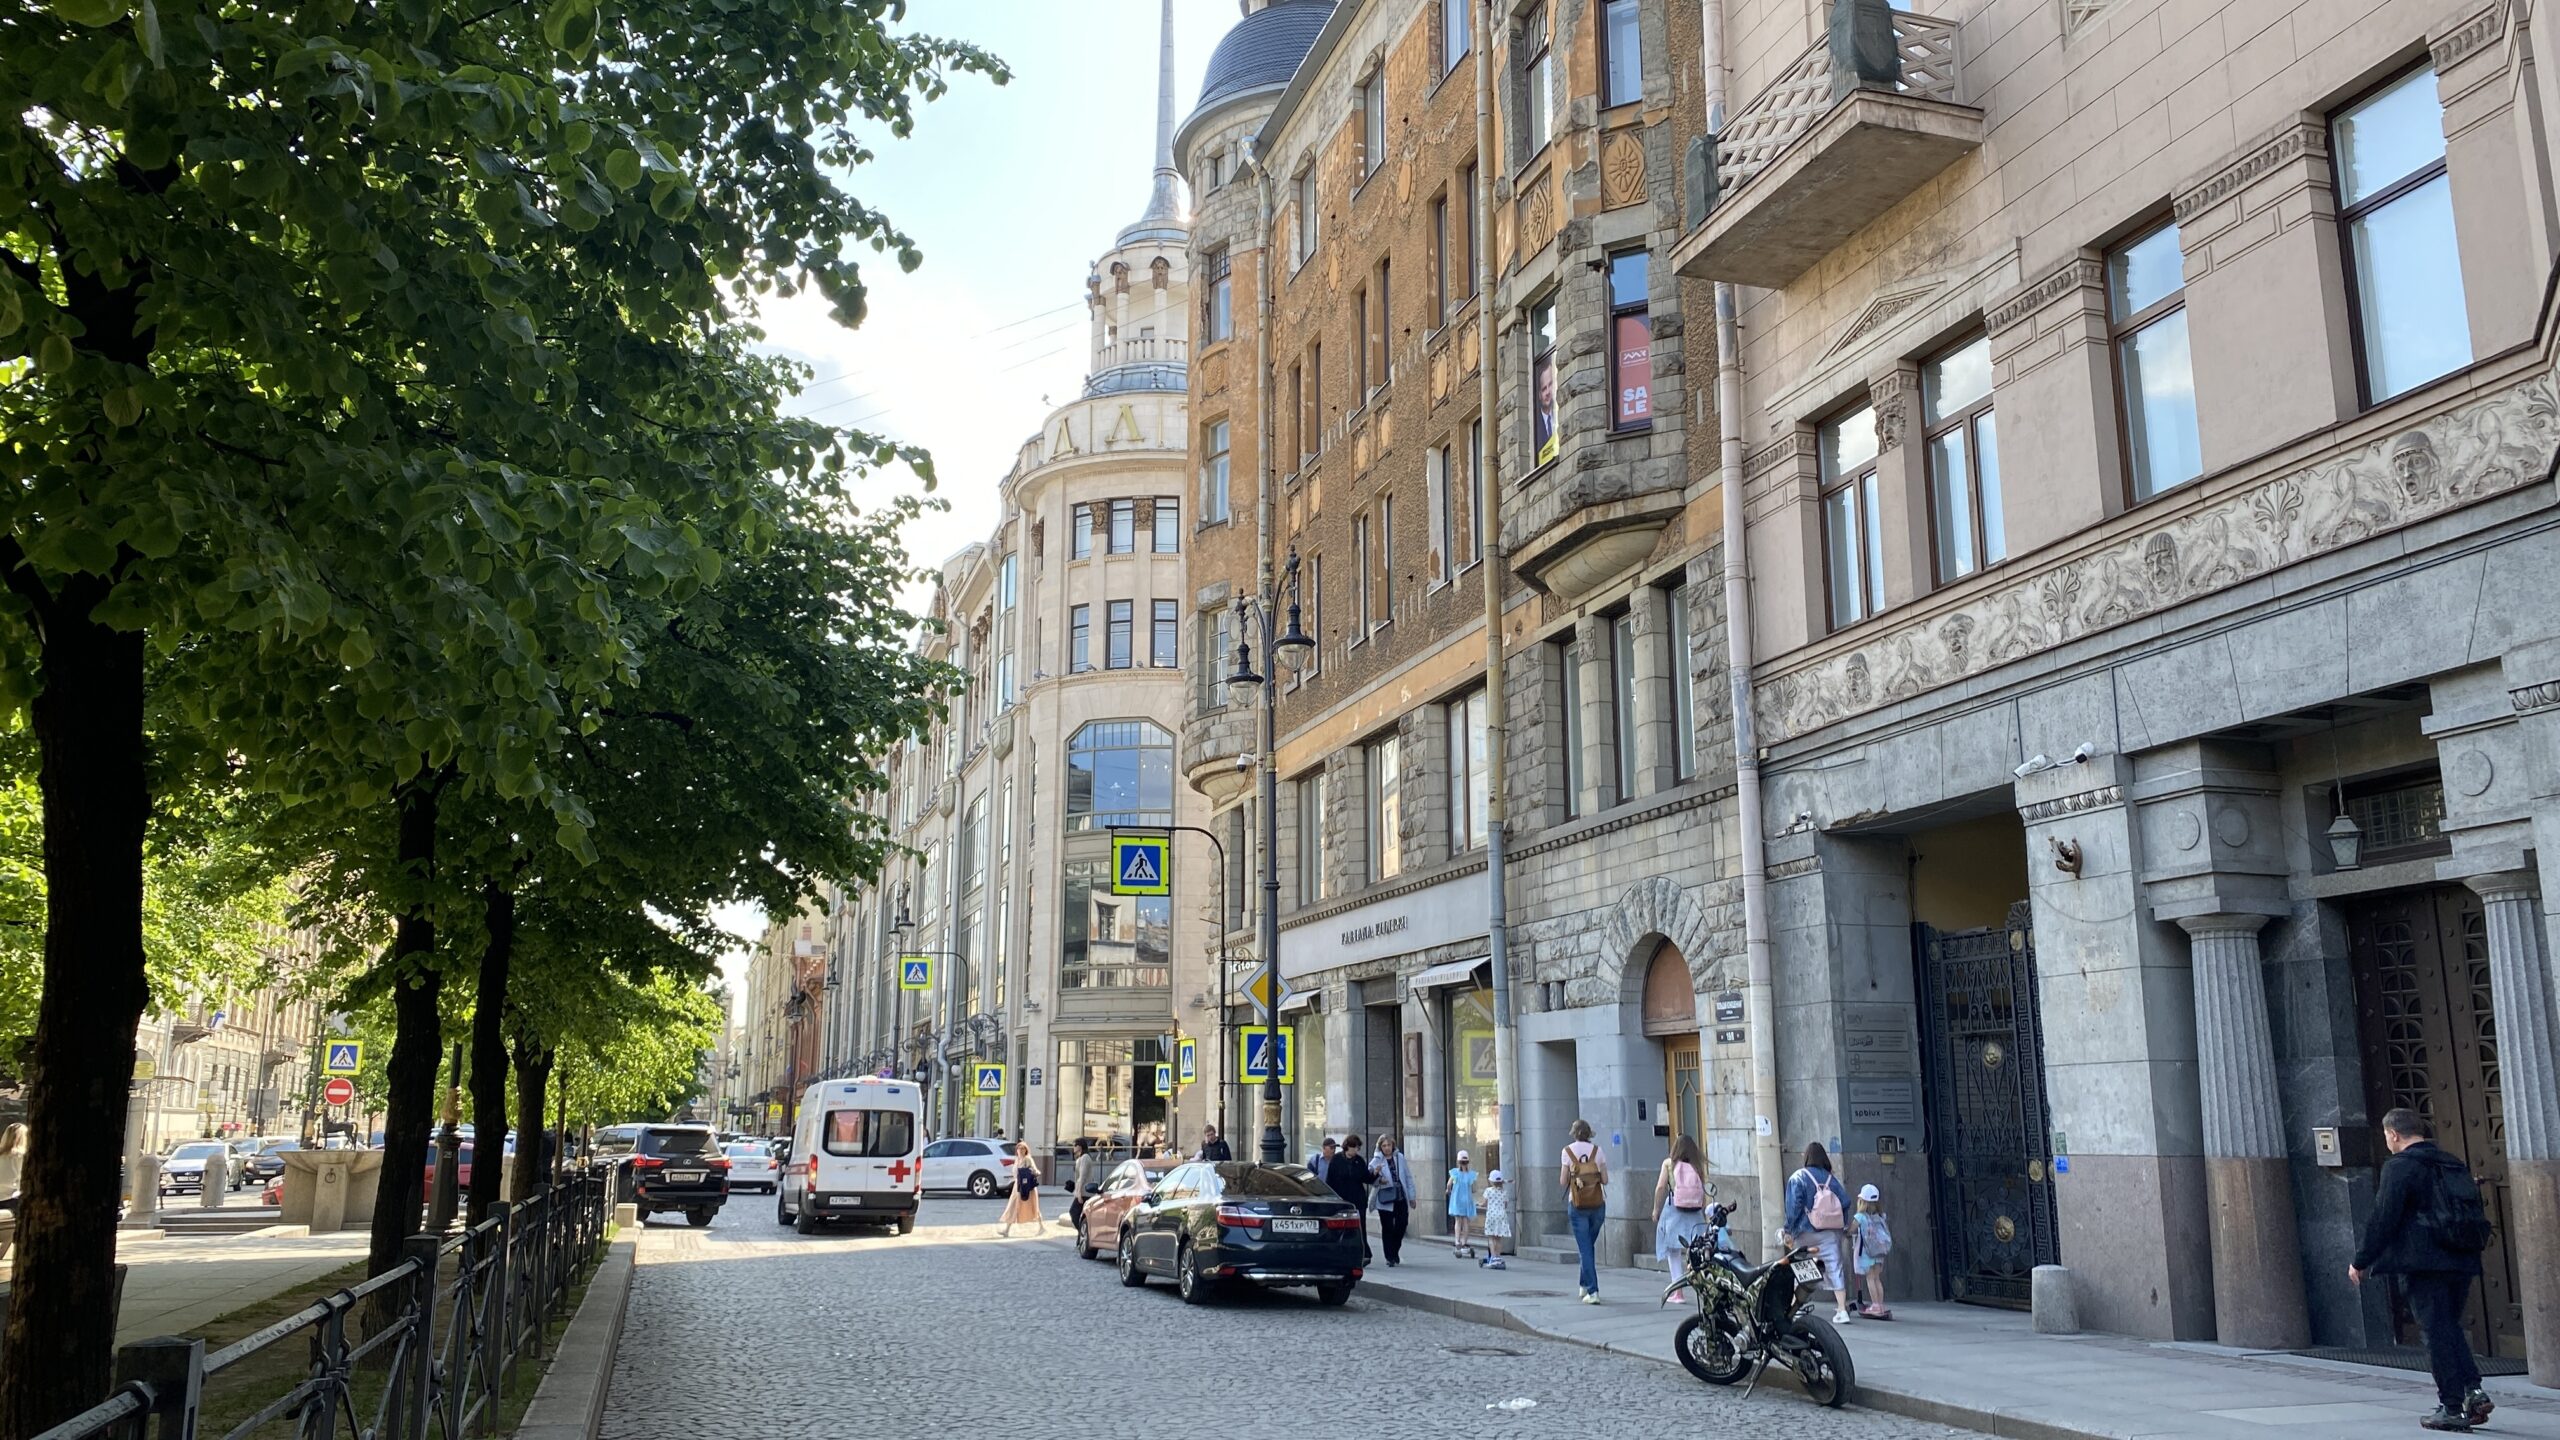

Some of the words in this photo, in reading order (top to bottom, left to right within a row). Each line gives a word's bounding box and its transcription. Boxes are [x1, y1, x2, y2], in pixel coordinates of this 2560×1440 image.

[1623, 386, 1648, 402] SA
[1623, 400, 1647, 416] LE
[1049, 403, 1188, 462] ДЛ
